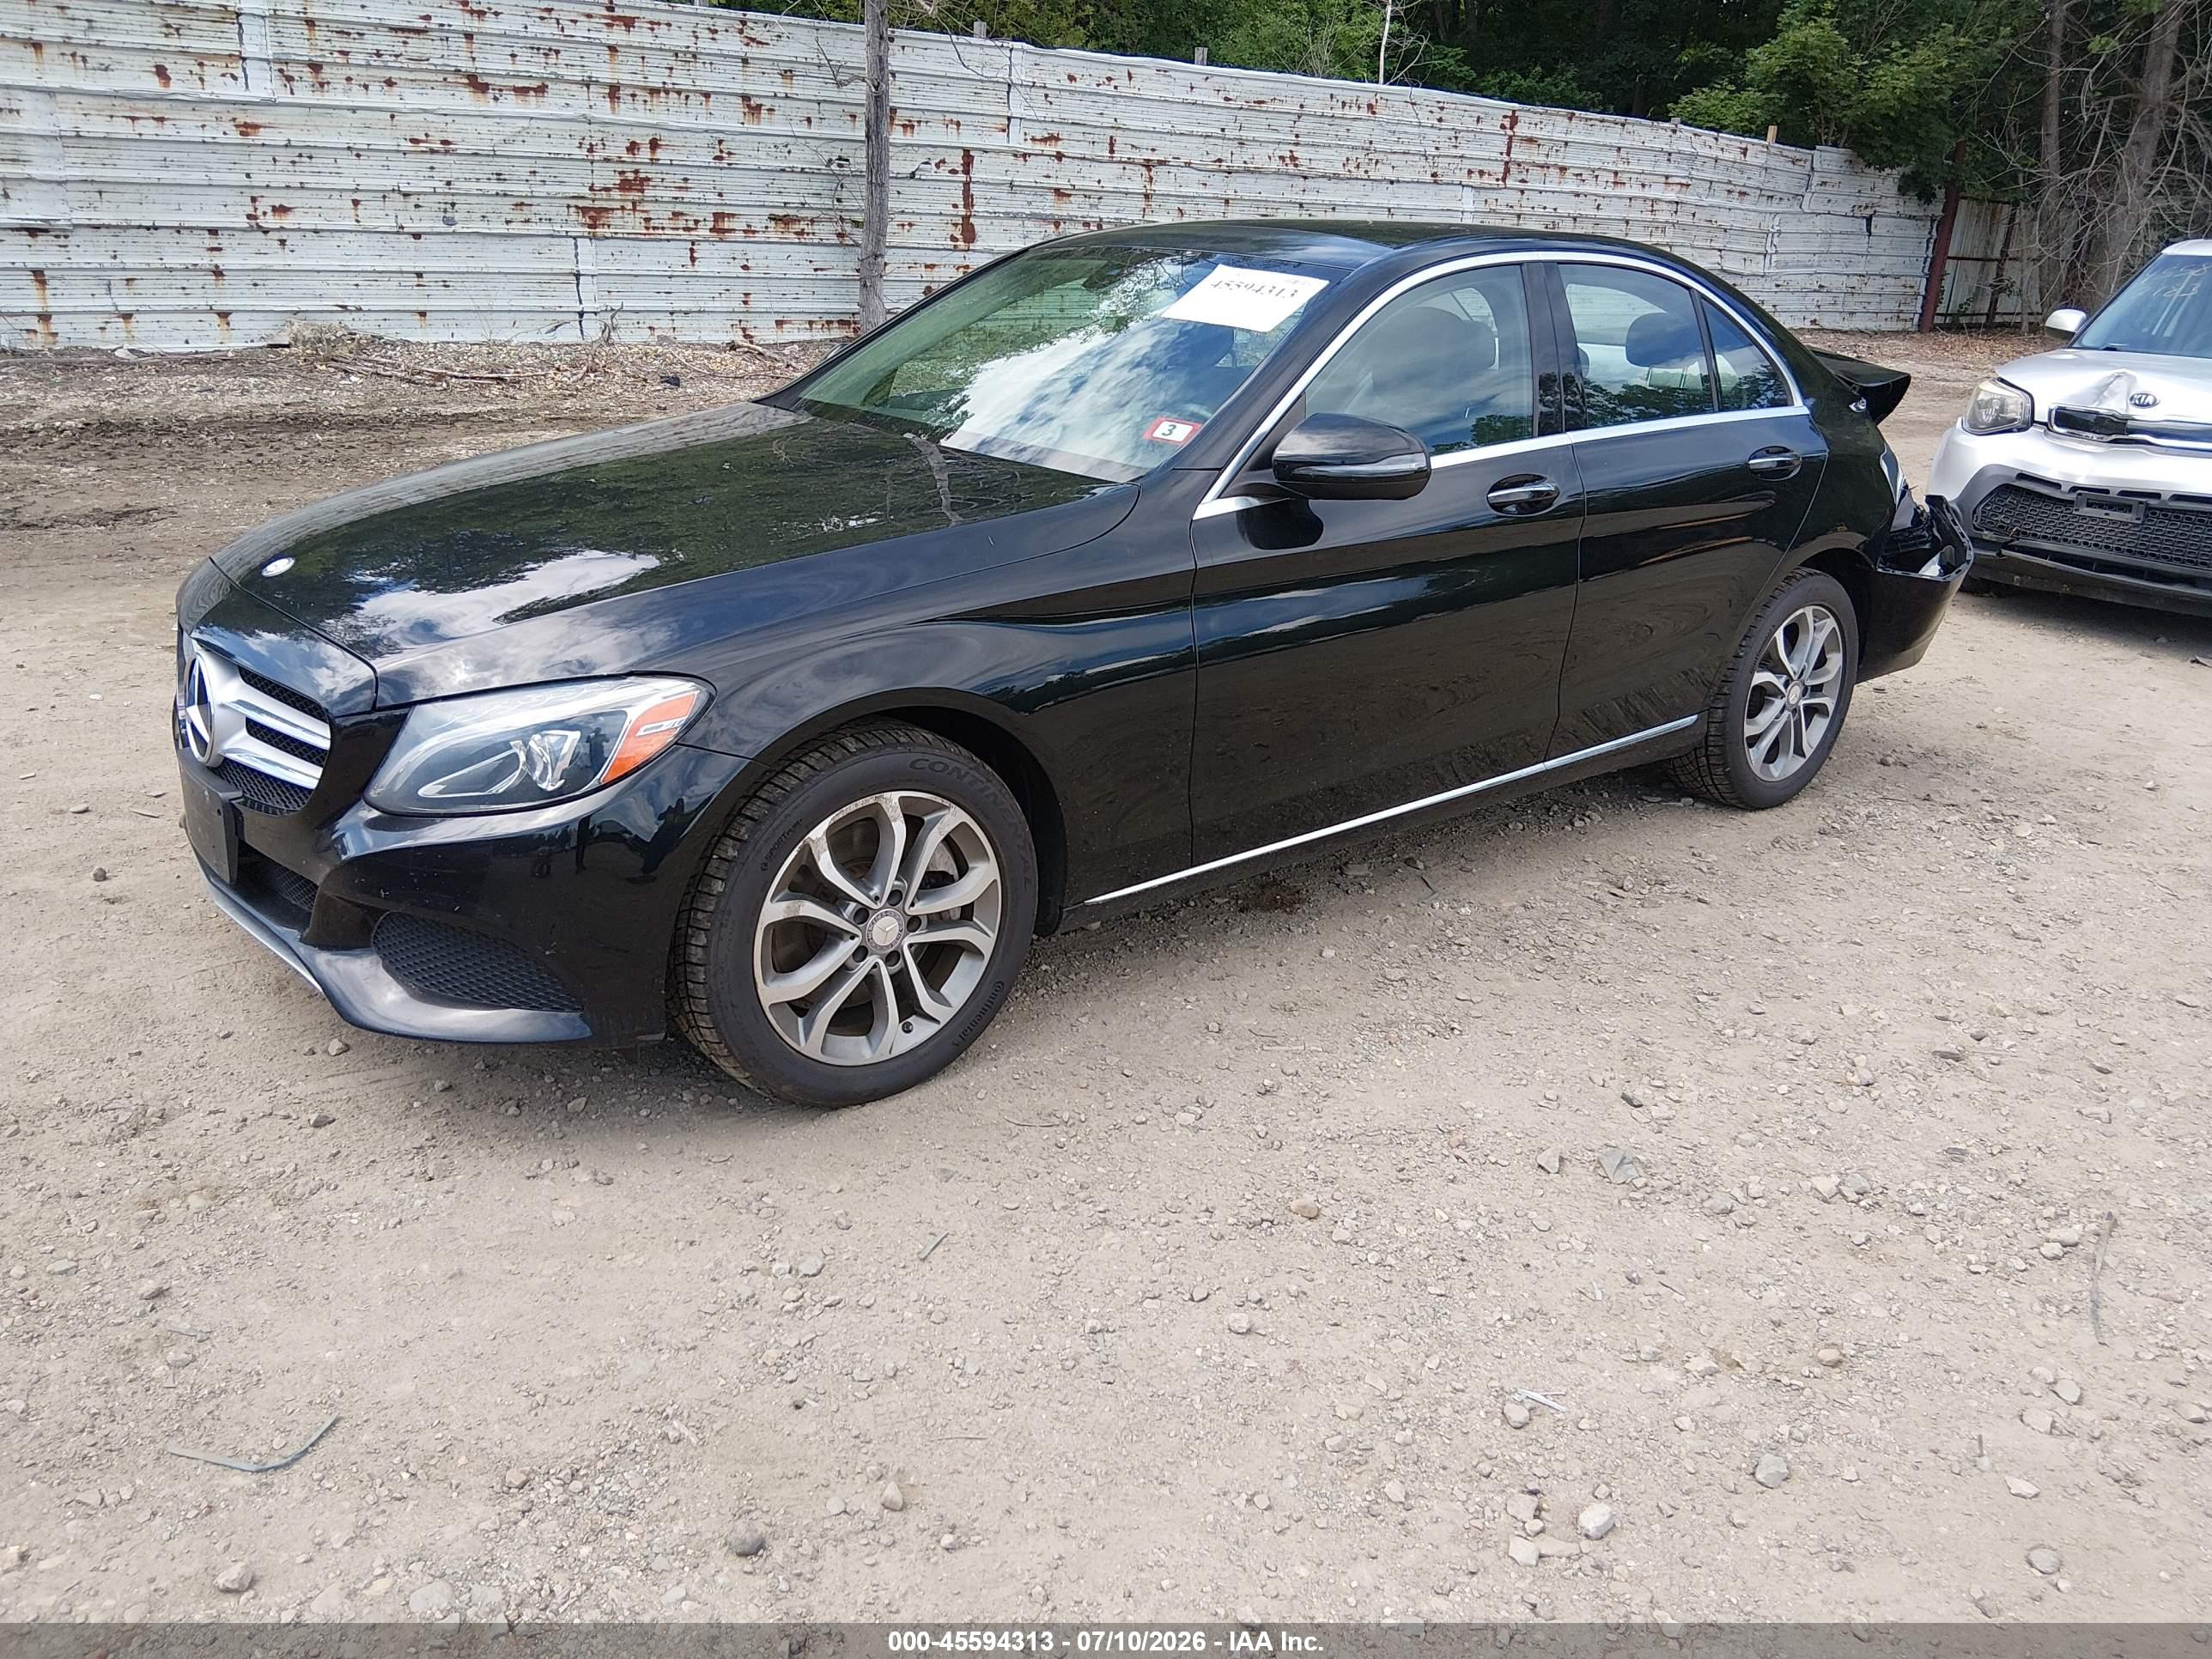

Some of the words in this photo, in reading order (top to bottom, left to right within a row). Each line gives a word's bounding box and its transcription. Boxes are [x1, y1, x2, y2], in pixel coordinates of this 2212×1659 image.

[1211, 280, 1298, 298] 45594313
[2130, 393, 2156, 405] KIA
[1161, 424, 1176, 436] 3
[908, 758, 1031, 891] CONTINENTAL
[957, 980, 1006, 1042] Continental
